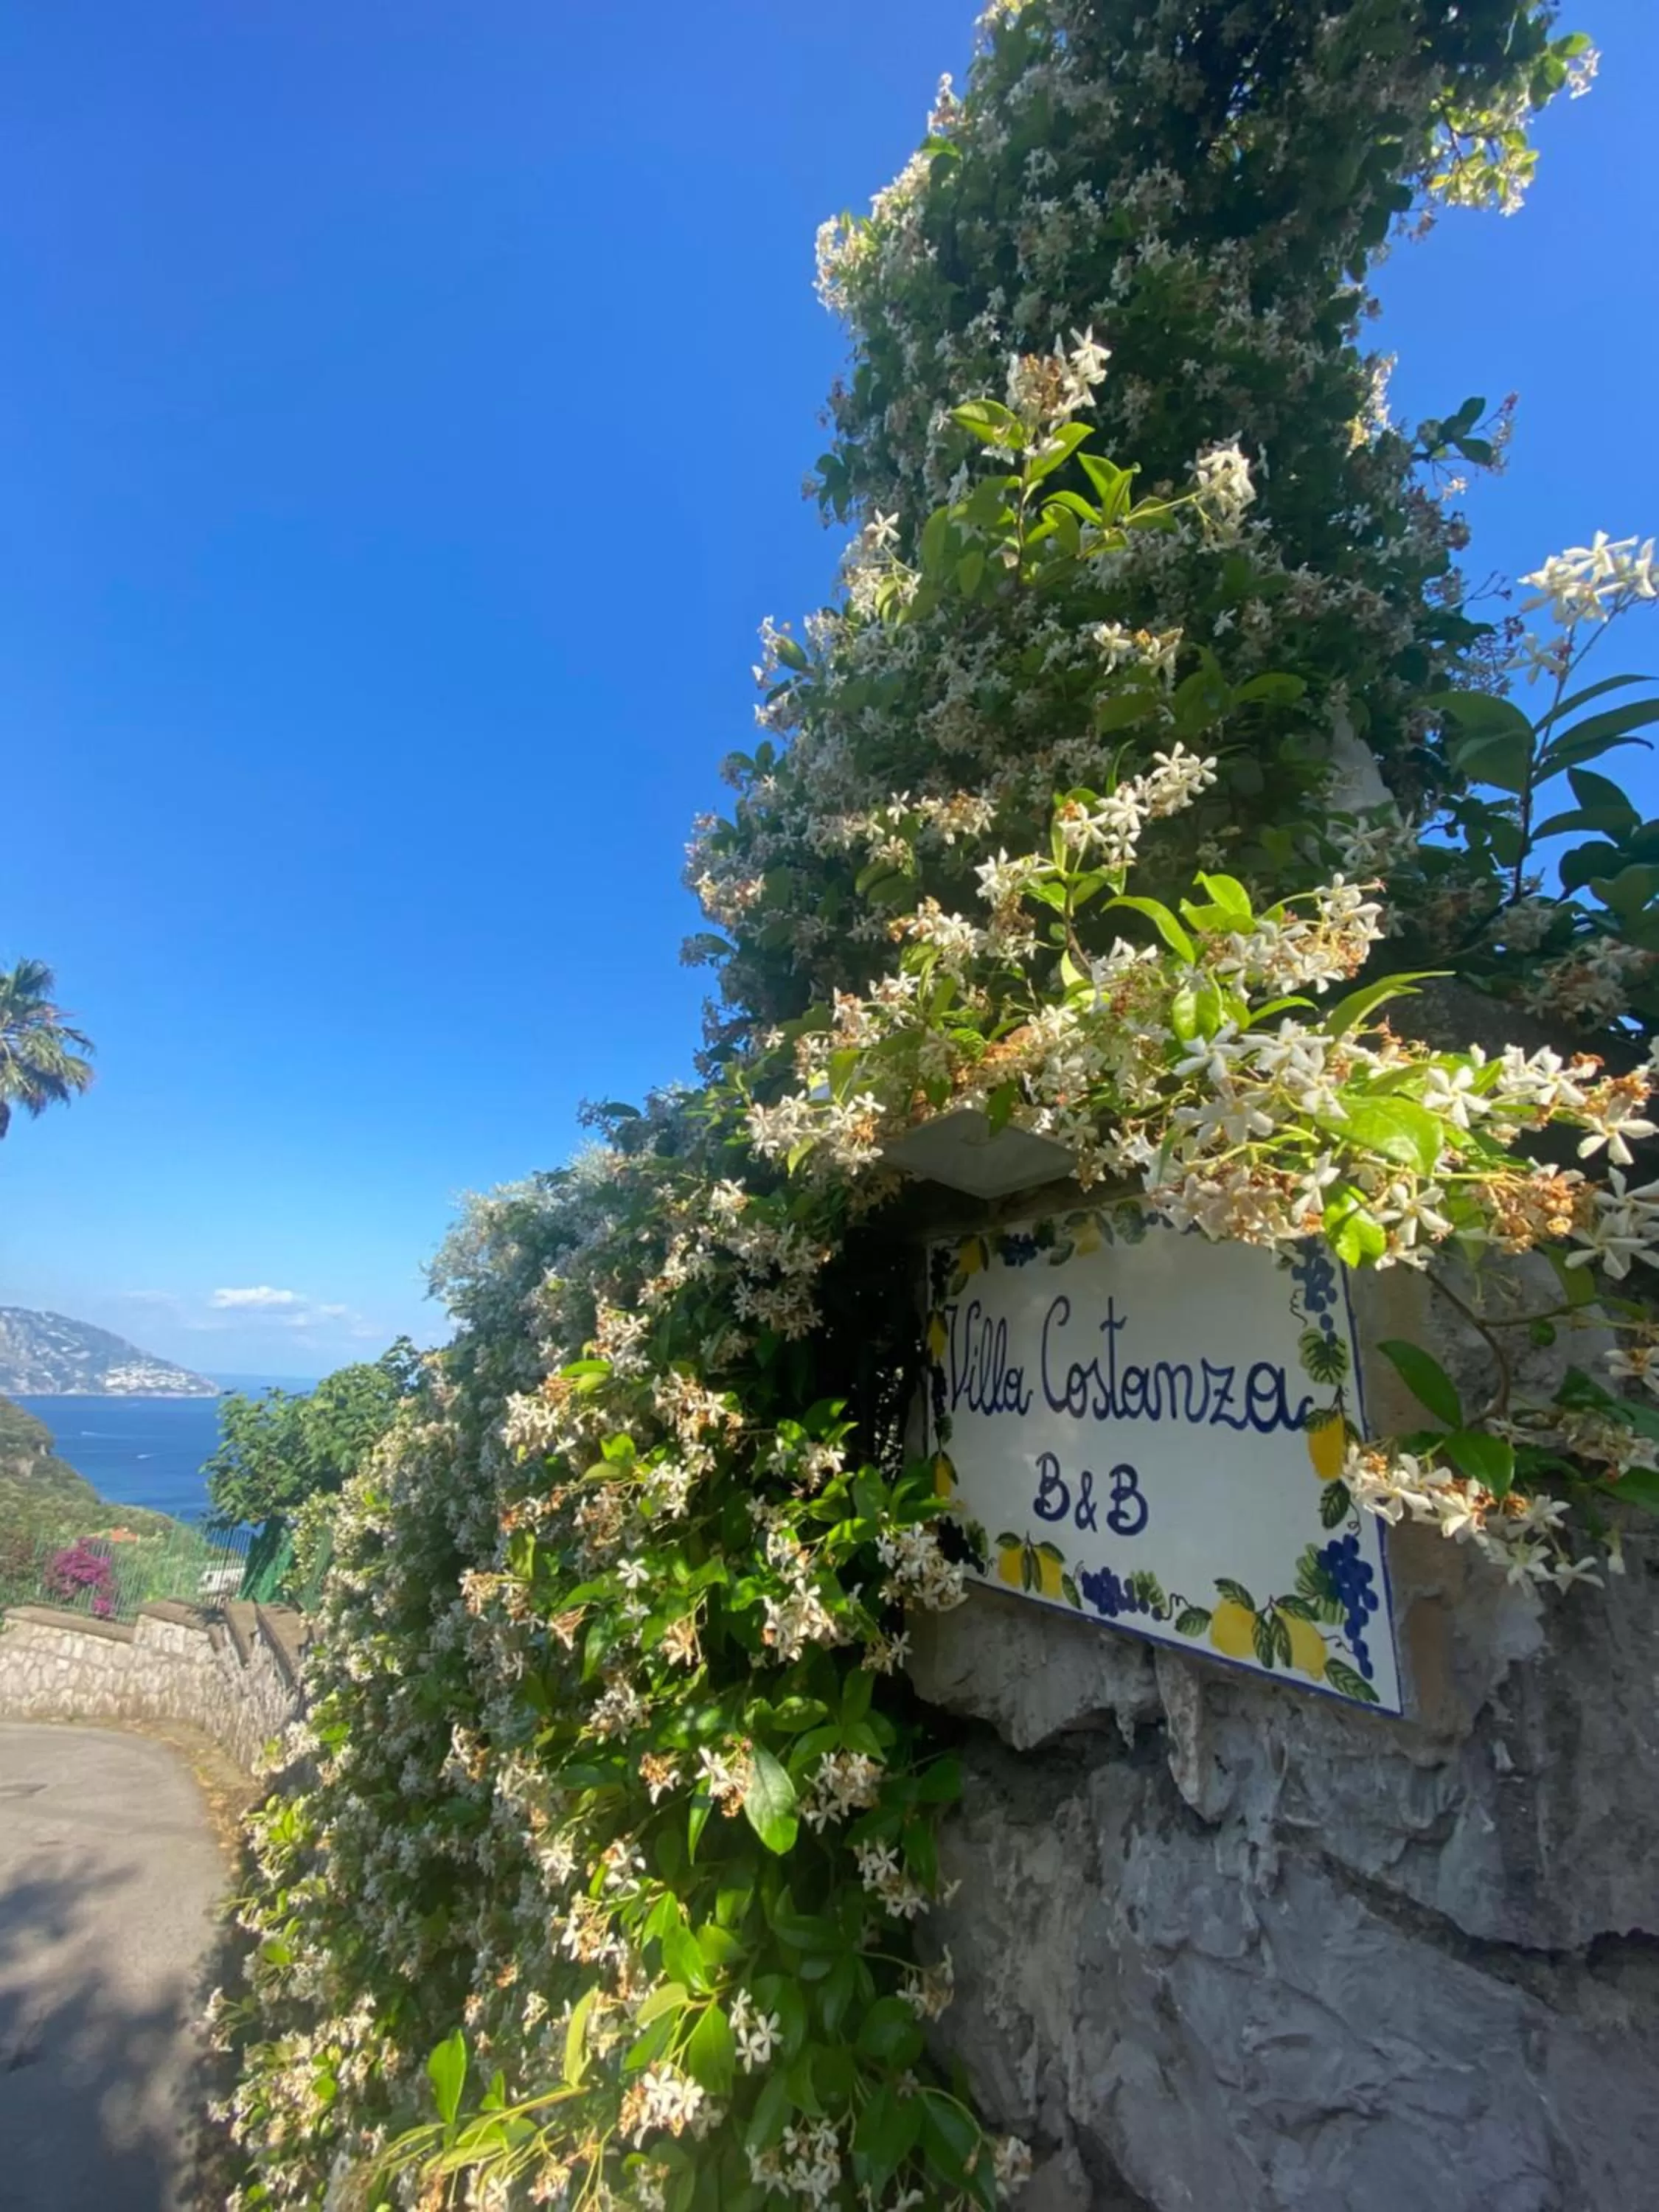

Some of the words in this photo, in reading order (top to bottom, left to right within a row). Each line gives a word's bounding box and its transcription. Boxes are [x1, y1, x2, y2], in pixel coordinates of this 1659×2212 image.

[945, 1299, 1032, 1416] Villa
[1041, 1295, 1314, 1433] Costanza
[1033, 1451, 1149, 1536] B&B
